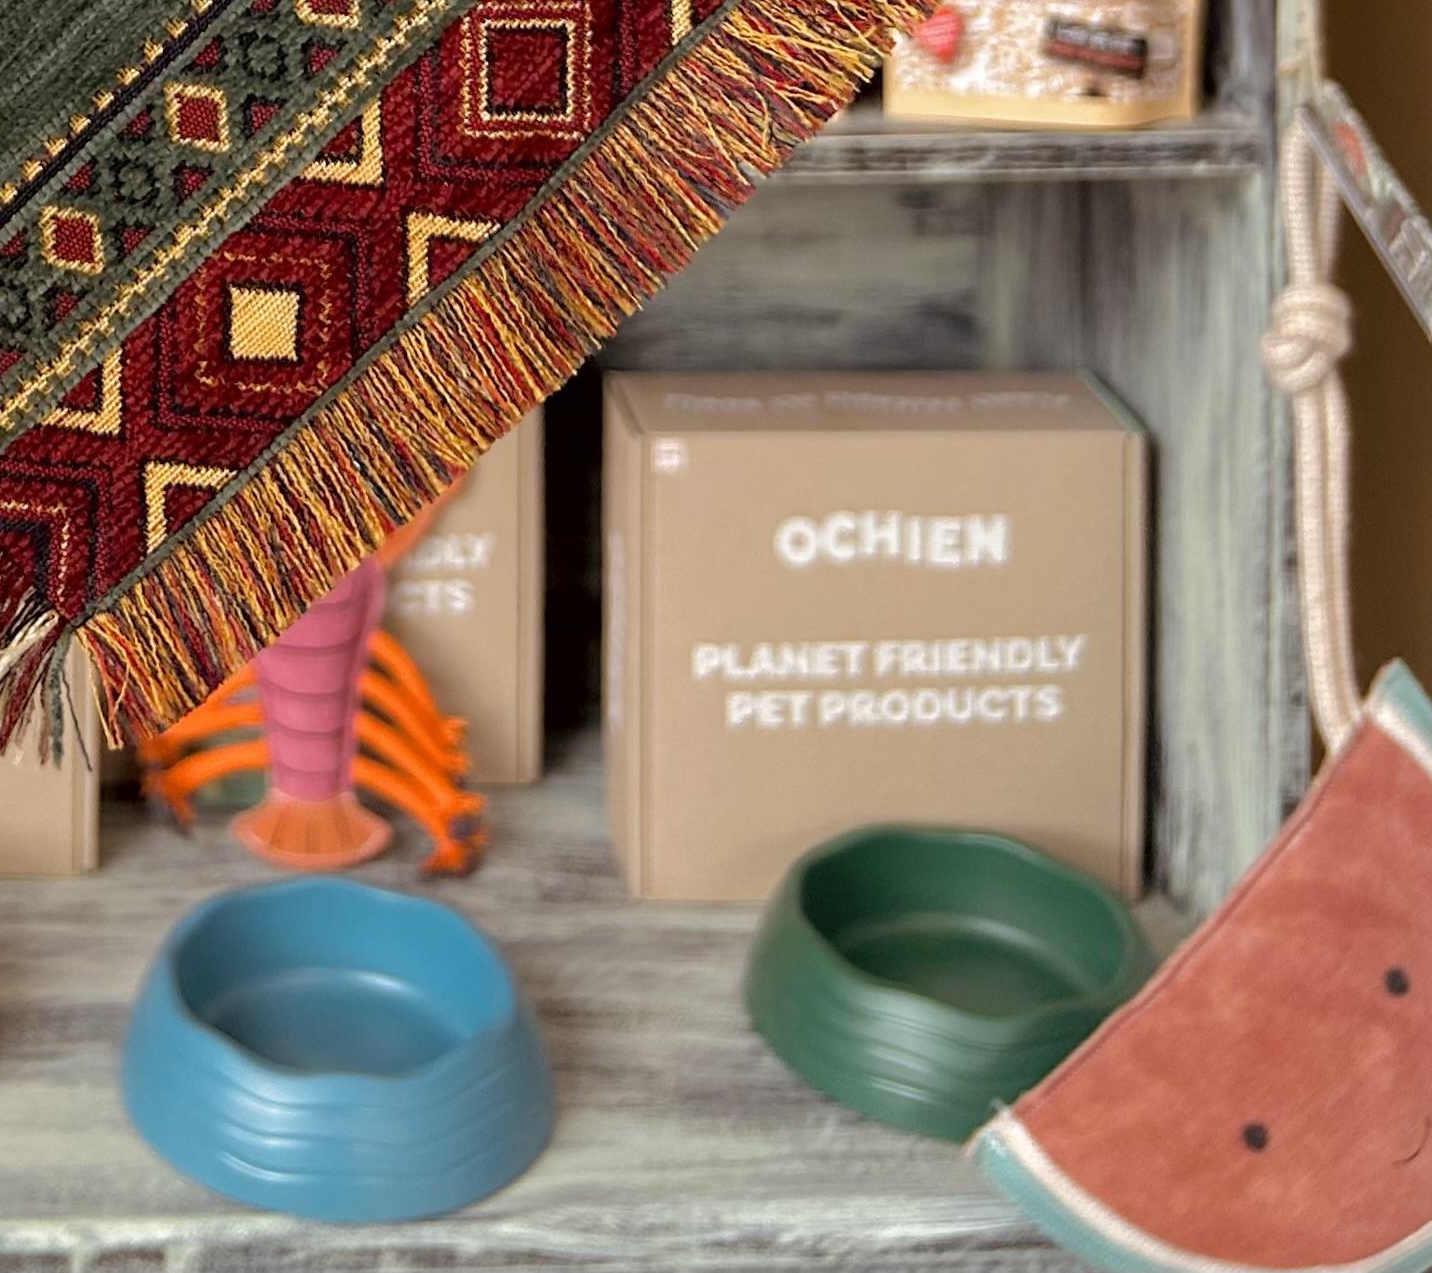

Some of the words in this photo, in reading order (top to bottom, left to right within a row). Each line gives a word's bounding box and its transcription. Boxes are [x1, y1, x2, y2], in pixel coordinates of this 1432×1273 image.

[776, 510, 1012, 567] OCHIEN
[692, 642, 868, 680] PLANET
[873, 635, 1086, 676] FRIENDLY
[726, 691, 812, 729] PET
[820, 685, 1063, 724] PRODUCTS
